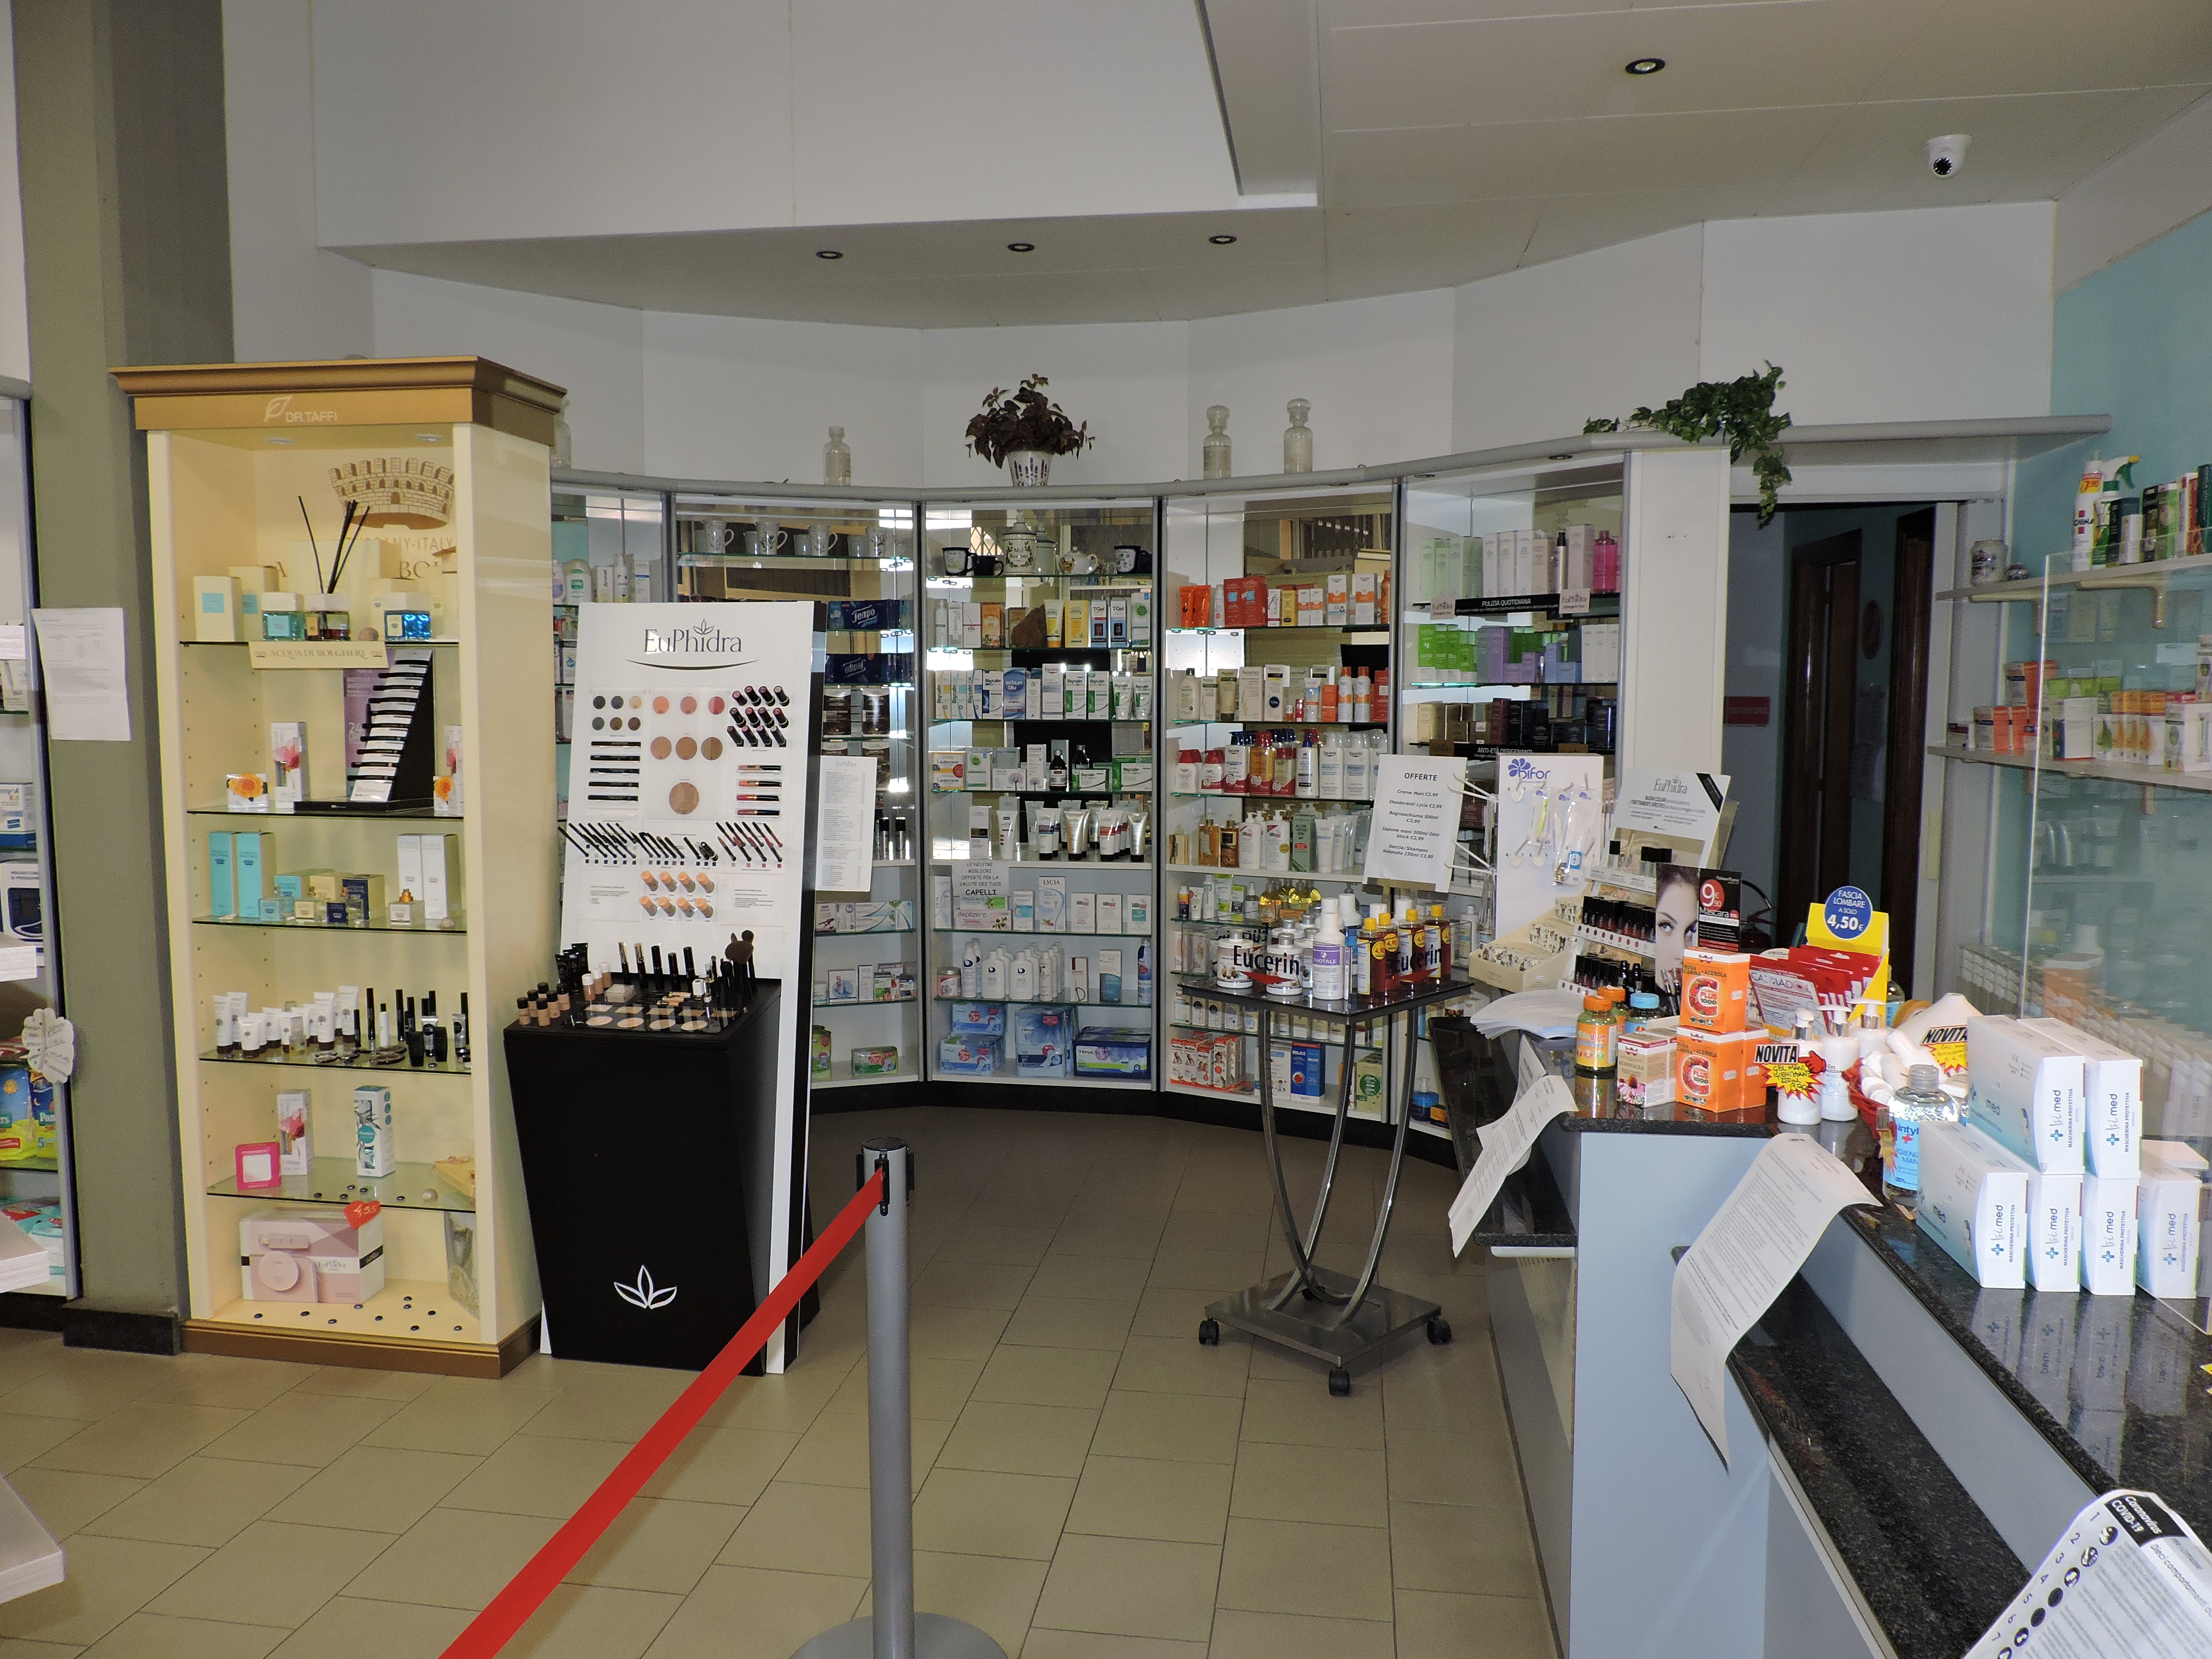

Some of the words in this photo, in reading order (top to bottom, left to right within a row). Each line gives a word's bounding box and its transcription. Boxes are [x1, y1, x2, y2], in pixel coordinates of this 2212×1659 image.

[285, 411, 337, 423] DR.TAFFI
[852, 607, 876, 624] Tempo
[644, 628, 743, 653] EuPhidra
[1404, 772, 1438, 781] OFFERTE
[1702, 883, 1715, 907] 9
[1838, 890, 1863, 900] FASCIA
[1833, 897, 1866, 909] LOMBARE
[1699, 907, 1729, 918] Mascara
[1233, 944, 1300, 976] Eucerin
[1385, 944, 1442, 974] Eucerin
[1705, 970, 1727, 978] ACEROLA
[1751, 972, 1811, 993] CAADOL
[1700, 991, 1717, 1000] PLUS
[1696, 1048, 1718, 1058] ACEROLA
[1755, 1045, 1798, 1063] NOVITA
[1693, 1070, 1709, 1079] PLUS
[1693, 1076, 1708, 1084] 1000
[2089, 1512, 2100, 1522] 1
[2112, 1500, 2145, 1533] COVID-19
[2125, 1496, 2163, 1535] Coronavirus
[2071, 1532, 2080, 1545] 2
[2055, 1552, 2065, 1564] 3
[2151, 1544, 2169, 1561] Dieci
[2040, 1573, 2050, 1584] 4
[2022, 1593, 2033, 1604] 5
[2007, 1613, 2017, 1624] 6
[1991, 1631, 2001, 1642] 7
